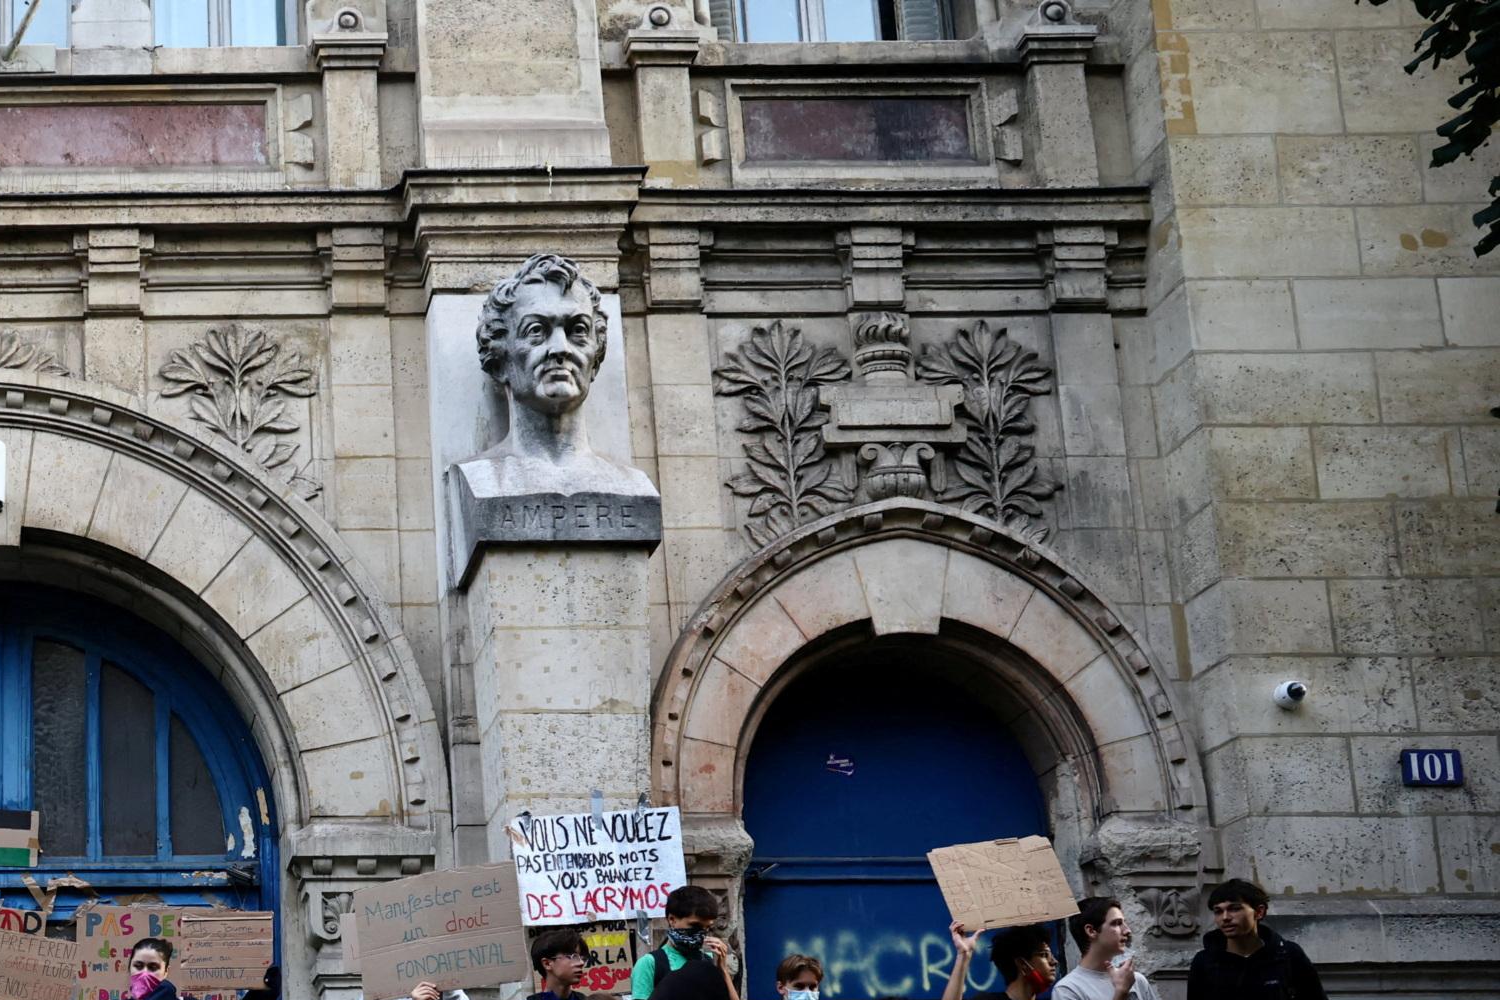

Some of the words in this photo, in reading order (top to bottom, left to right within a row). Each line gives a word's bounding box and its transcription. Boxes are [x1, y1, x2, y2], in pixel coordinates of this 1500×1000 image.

[499, 504, 637, 529] AMPERE
[1409, 752, 1456, 782] 101
[519, 816, 569, 853] VOUS
[574, 815, 597, 846] NE
[602, 812, 672, 843] VOULEZ
[517, 854, 542, 874] PAS
[593, 851, 615, 867] NOS
[619, 849, 659, 865] MOTS
[548, 872, 588, 890] VOUS
[595, 867, 655, 884] BALANCEZ
[364, 888, 460, 926] Manifester
[471, 878, 502, 896] est
[526, 893, 563, 921] DES
[571, 882, 671, 916] LACRYMOS
[86, 912, 134, 937] PAS
[402, 926, 428, 943] un
[445, 906, 490, 933] droit
[99, 940, 117, 959] de
[605, 947, 627, 964] LA
[4, 978, 29, 999] NOUS
